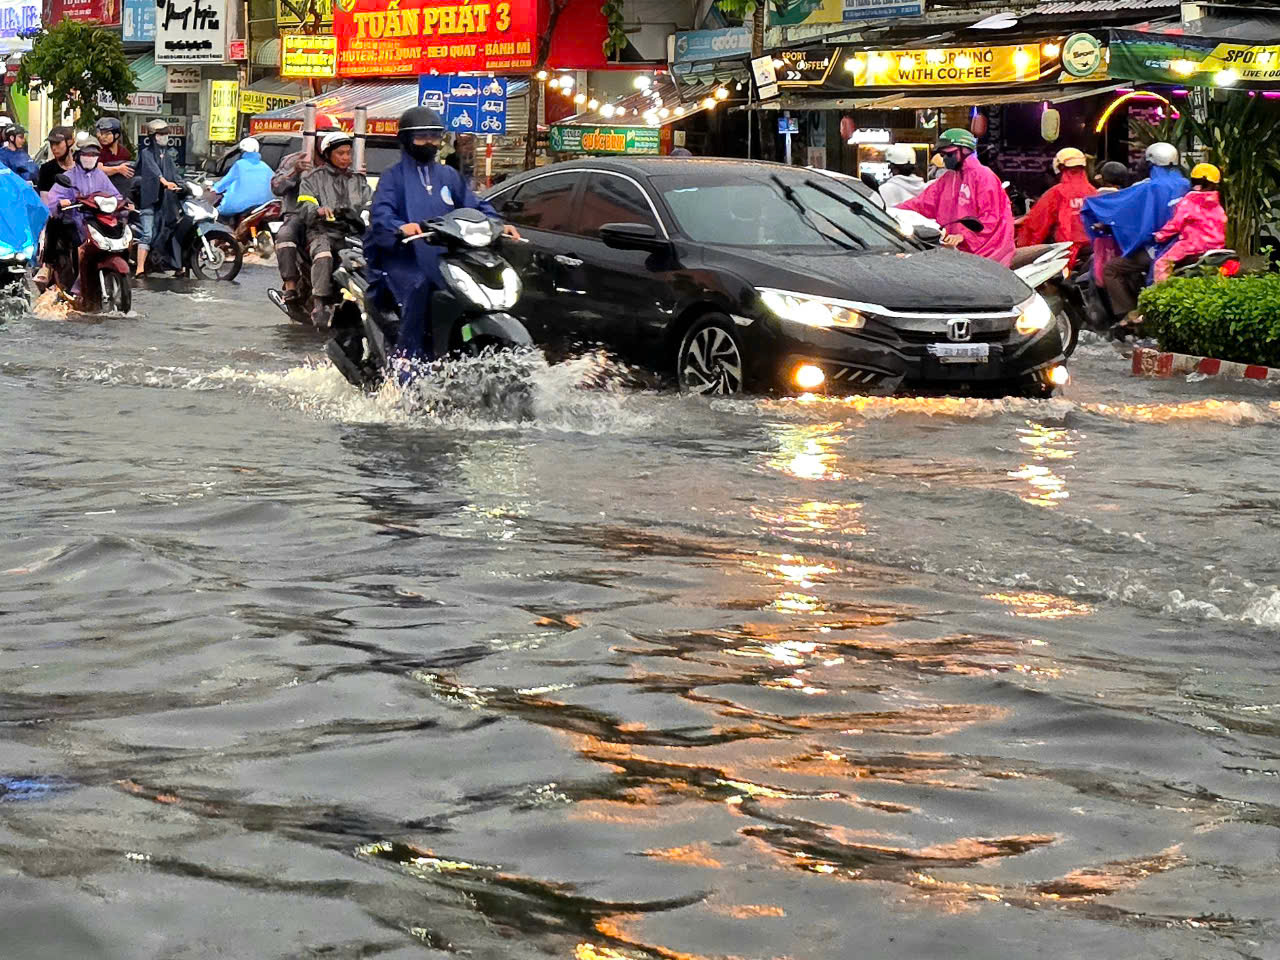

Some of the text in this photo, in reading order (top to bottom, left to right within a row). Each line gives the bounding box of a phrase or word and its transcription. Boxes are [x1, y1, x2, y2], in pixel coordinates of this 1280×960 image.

[353, 0, 420, 39] TUẤN
[495, 2, 511, 32] 3
[449, 44, 477, 58] QUAY
[485, 40, 514, 55] BÁNH
[516, 38, 531, 54] MÌ
[782, 52, 807, 61] SPORT
[898, 66, 991, 80] WITH COFFEE
